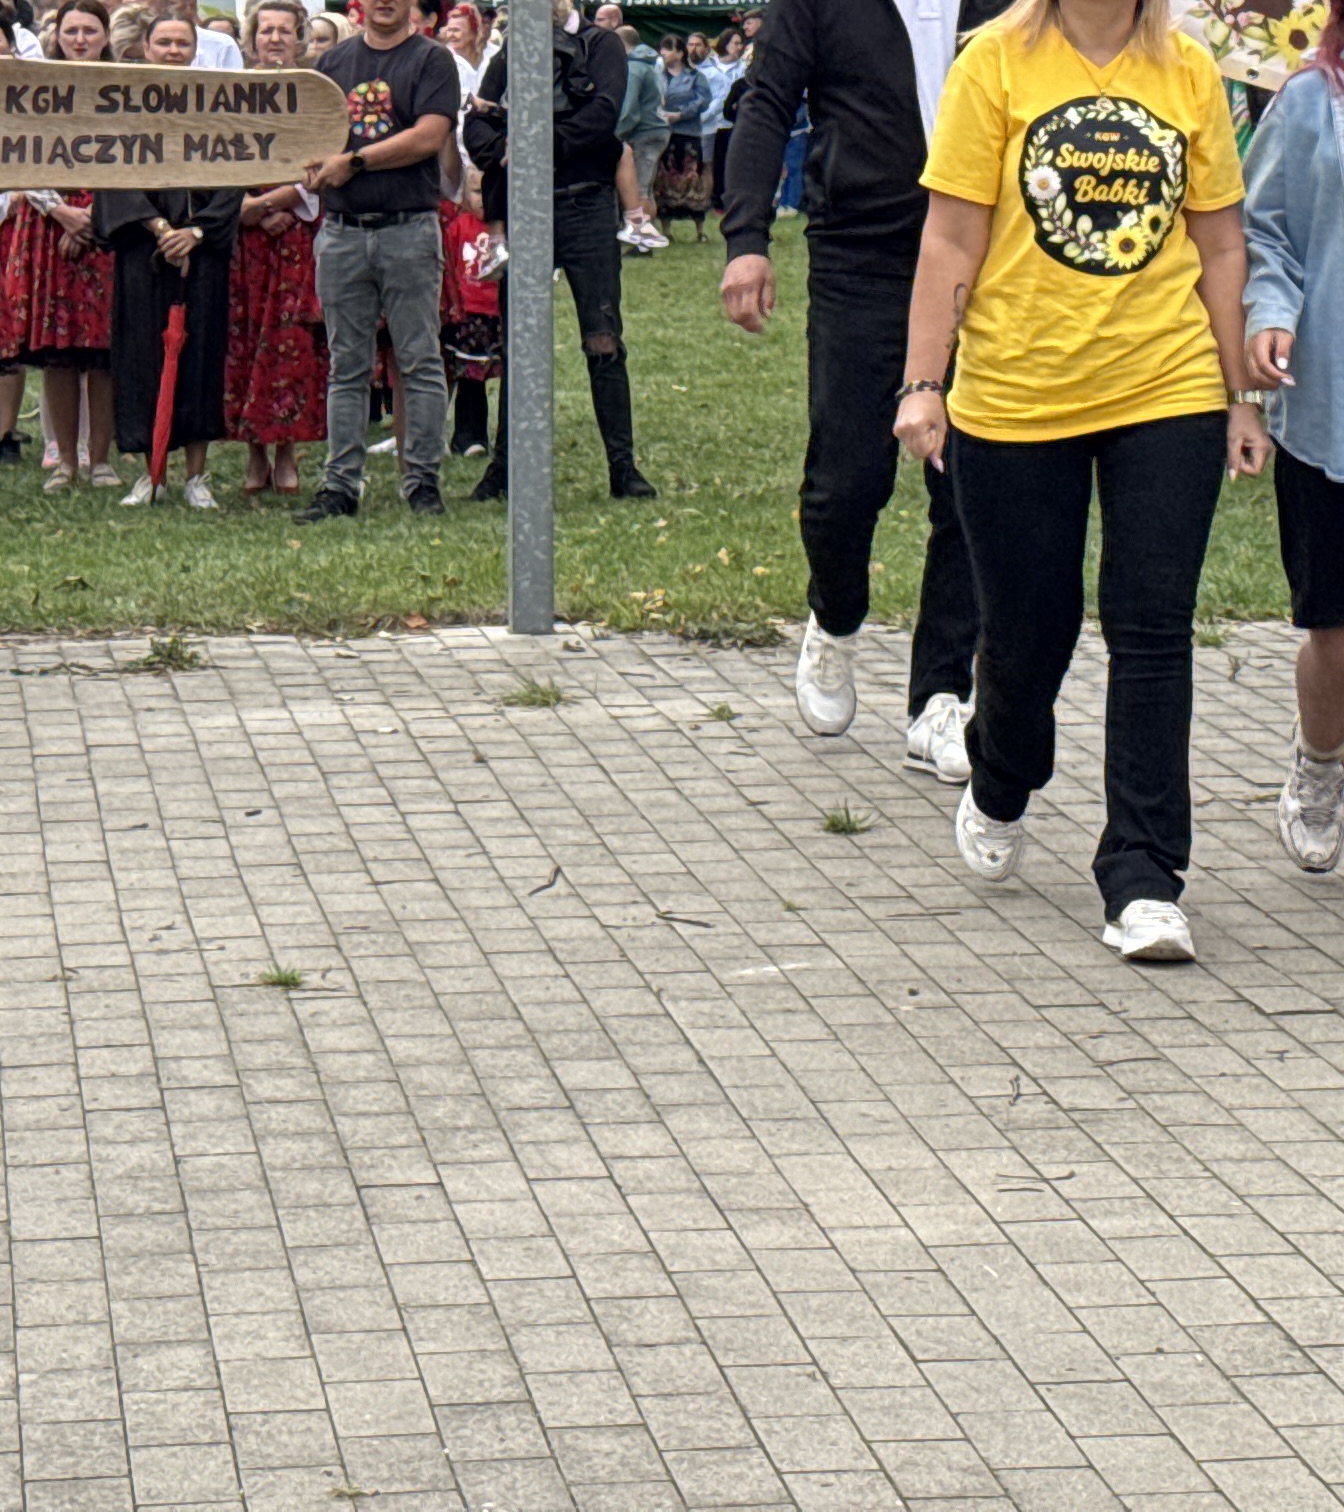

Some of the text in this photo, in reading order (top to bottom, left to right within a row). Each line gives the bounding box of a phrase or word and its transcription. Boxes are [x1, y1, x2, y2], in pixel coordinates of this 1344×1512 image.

[5, 82, 298, 115] KGW SŁOWIANKI
[1, 133, 277, 169] MIĄCZYN MAŁY
[1055, 143, 1162, 177] Swojskie
[1073, 174, 1150, 206] Babki
